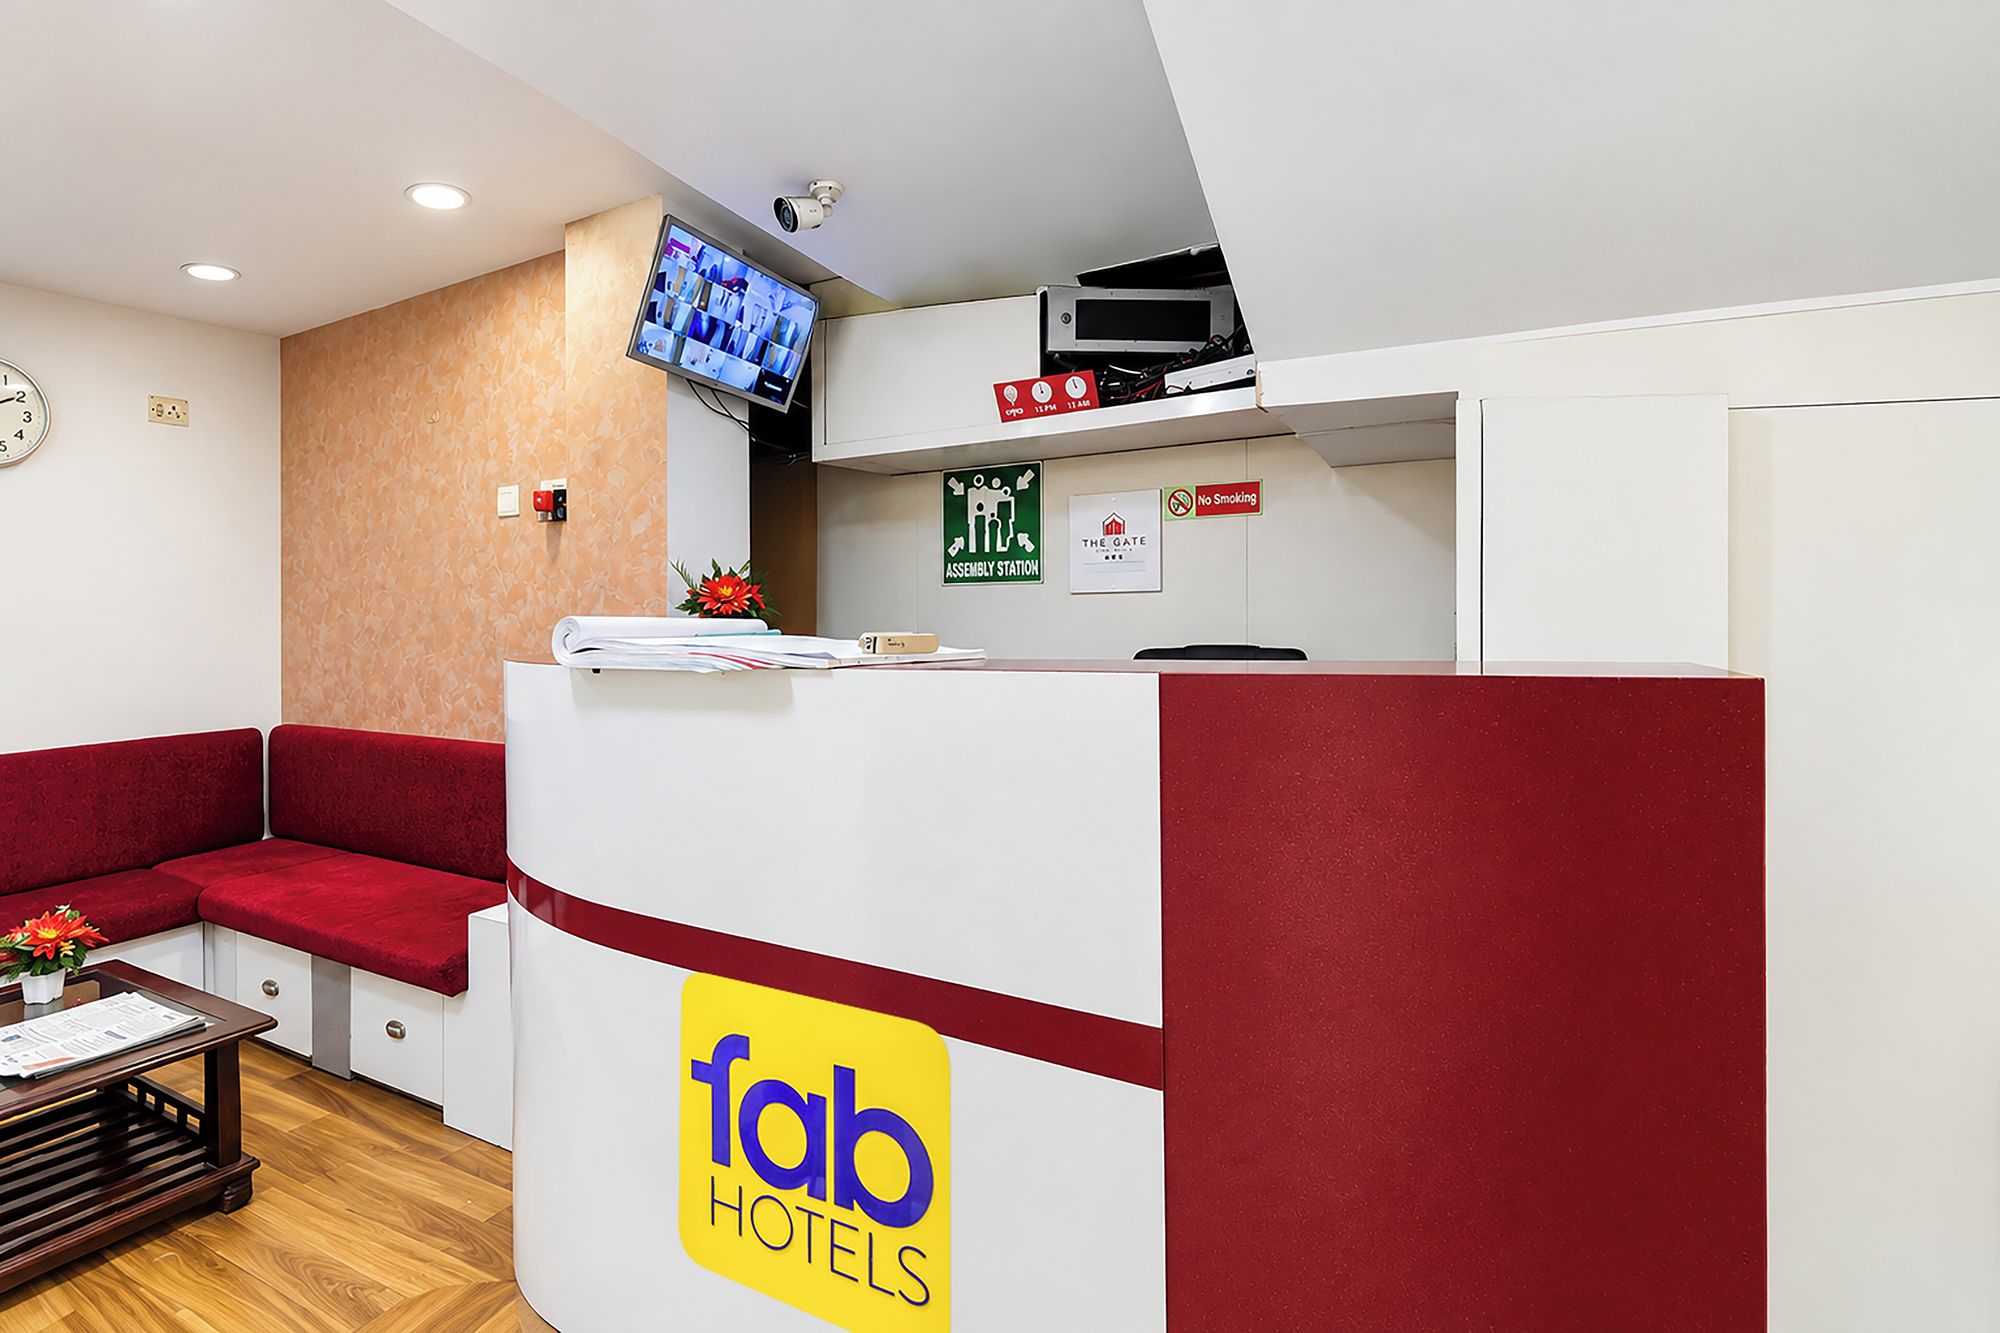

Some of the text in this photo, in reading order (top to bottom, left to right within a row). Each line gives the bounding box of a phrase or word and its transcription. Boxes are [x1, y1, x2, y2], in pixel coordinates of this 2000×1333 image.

[16, 391, 26, 403] 2
[23, 411, 32, 423] 3
[13, 429, 24, 440] 4
[0, 440, 8, 452] 5
[1197, 491, 1257, 506] No Smoking
[1082, 536, 1147, 548] THE GATE
[945, 559, 1039, 578] ASSEMBLY STATION
[691, 1033, 934, 1229] fab
[711, 1175, 931, 1308] HOTELS
